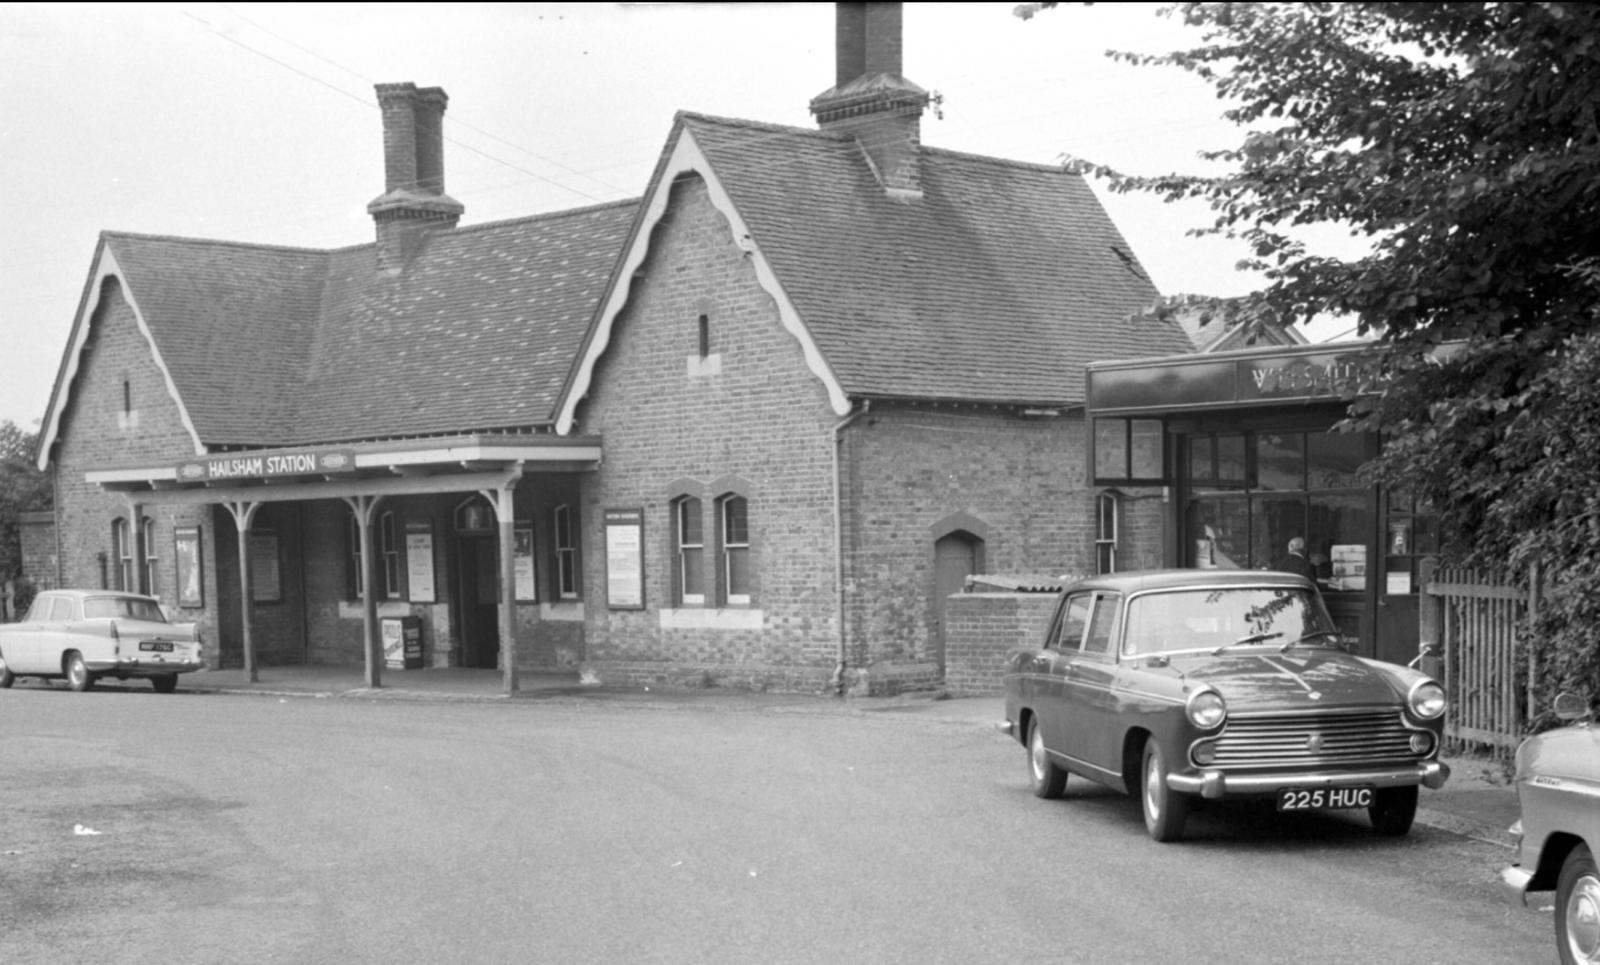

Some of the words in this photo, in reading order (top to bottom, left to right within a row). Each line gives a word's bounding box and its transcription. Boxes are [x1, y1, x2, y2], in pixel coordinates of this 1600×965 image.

[208, 458, 263, 478] HAILSHAM
[267, 453, 316, 474] STATION
[1282, 789, 1325, 810] 225
[1328, 788, 1371, 807] HUC
